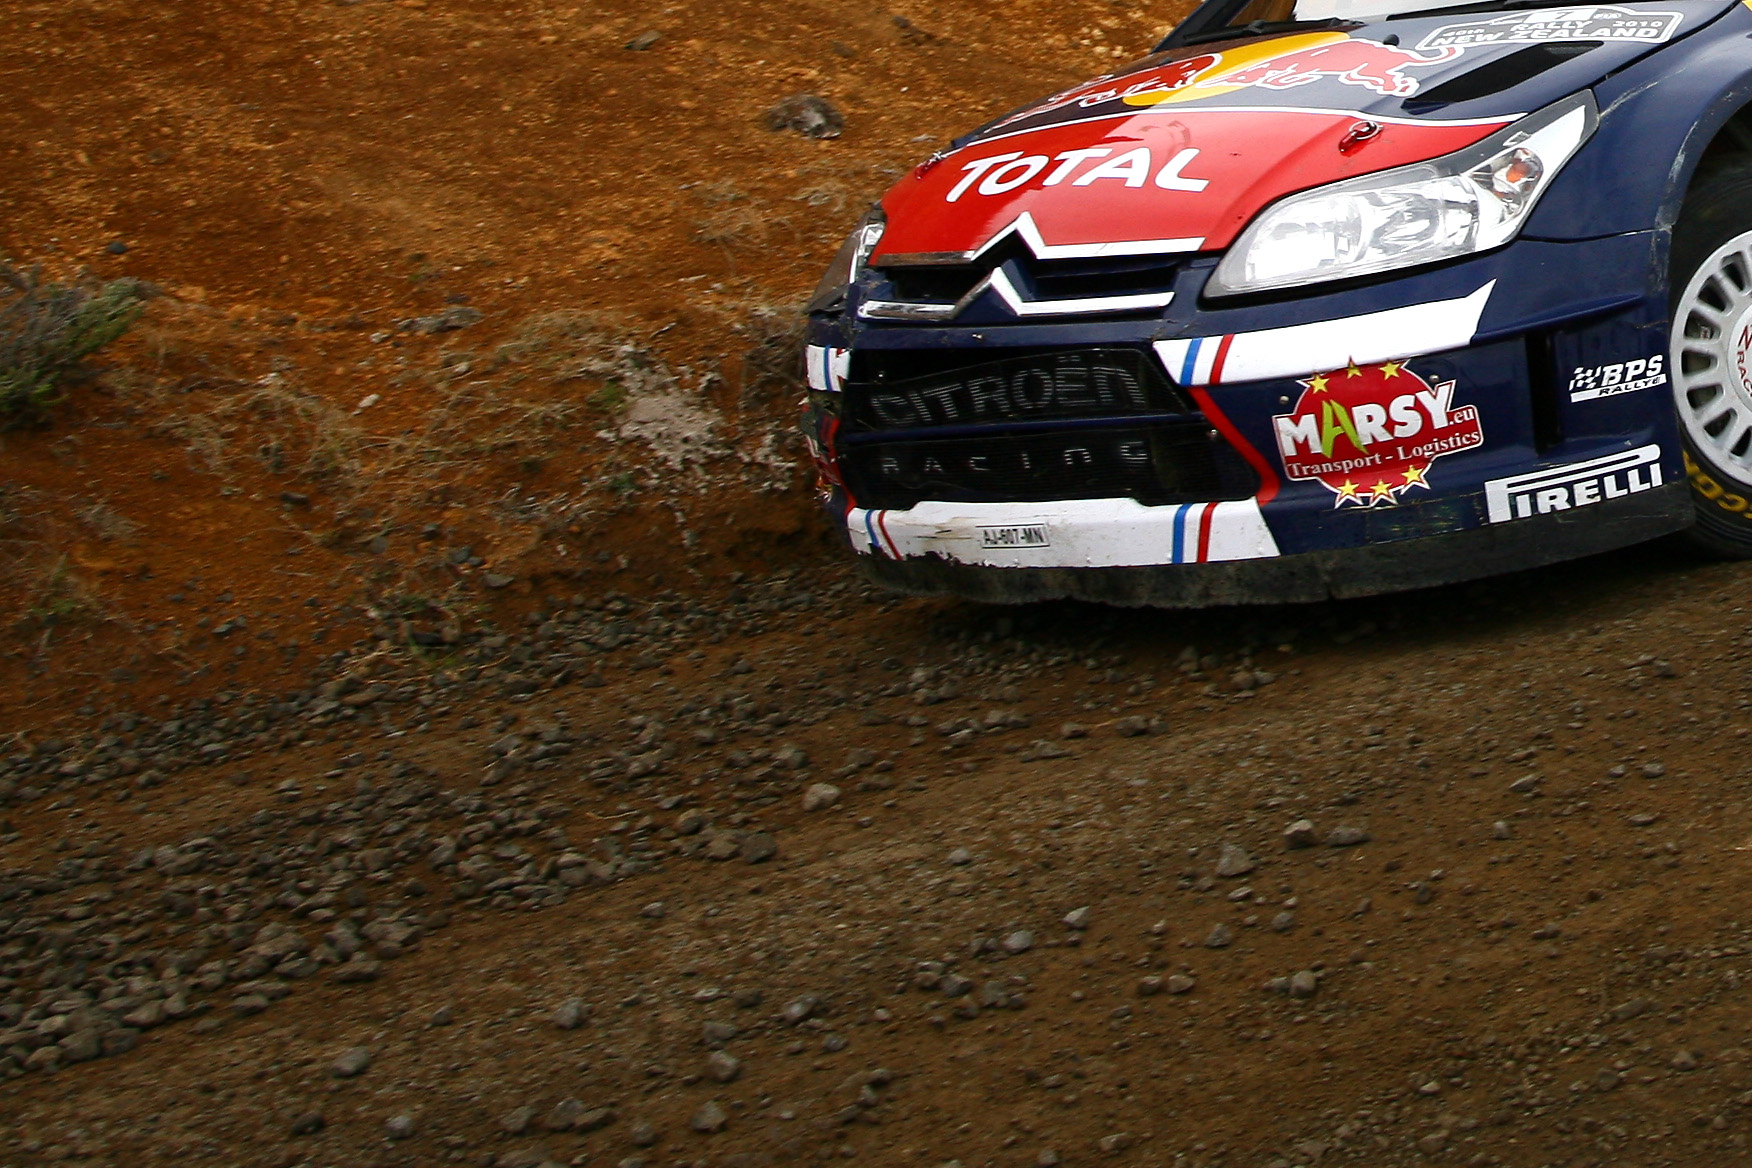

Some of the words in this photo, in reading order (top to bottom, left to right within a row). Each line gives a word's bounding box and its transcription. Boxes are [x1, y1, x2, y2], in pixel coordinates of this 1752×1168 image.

[1431, 32, 1504, 46] NEW
[1508, 28, 1659, 39] ZEALAND
[1510, 20, 1593, 32] RALLY
[1612, 20, 1663, 28] 2010
[945, 146, 1210, 203] TOTAL
[1601, 354, 1663, 386] BPS
[1287, 452, 1382, 477] Transport
[1397, 430, 1480, 459] Logistics
[1485, 443, 1663, 523] PIRELLI
